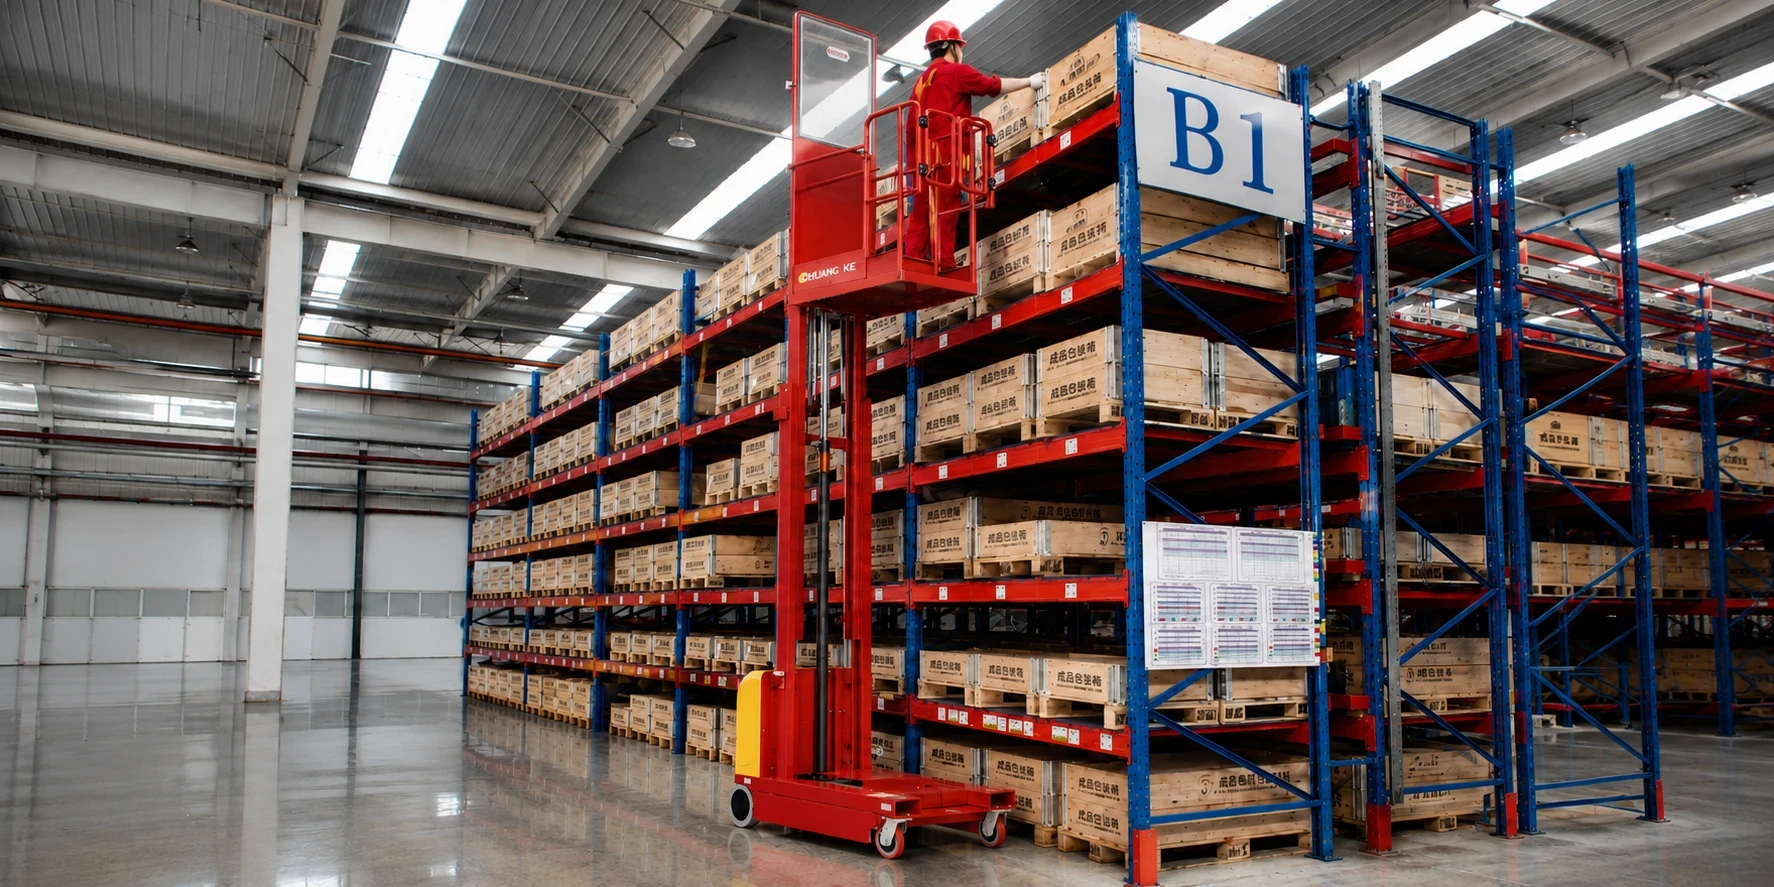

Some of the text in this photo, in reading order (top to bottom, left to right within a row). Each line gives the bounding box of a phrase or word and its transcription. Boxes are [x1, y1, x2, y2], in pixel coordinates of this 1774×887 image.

[1167, 87, 1274, 194] B1
[798, 262, 856, 283] CHUANG KE
